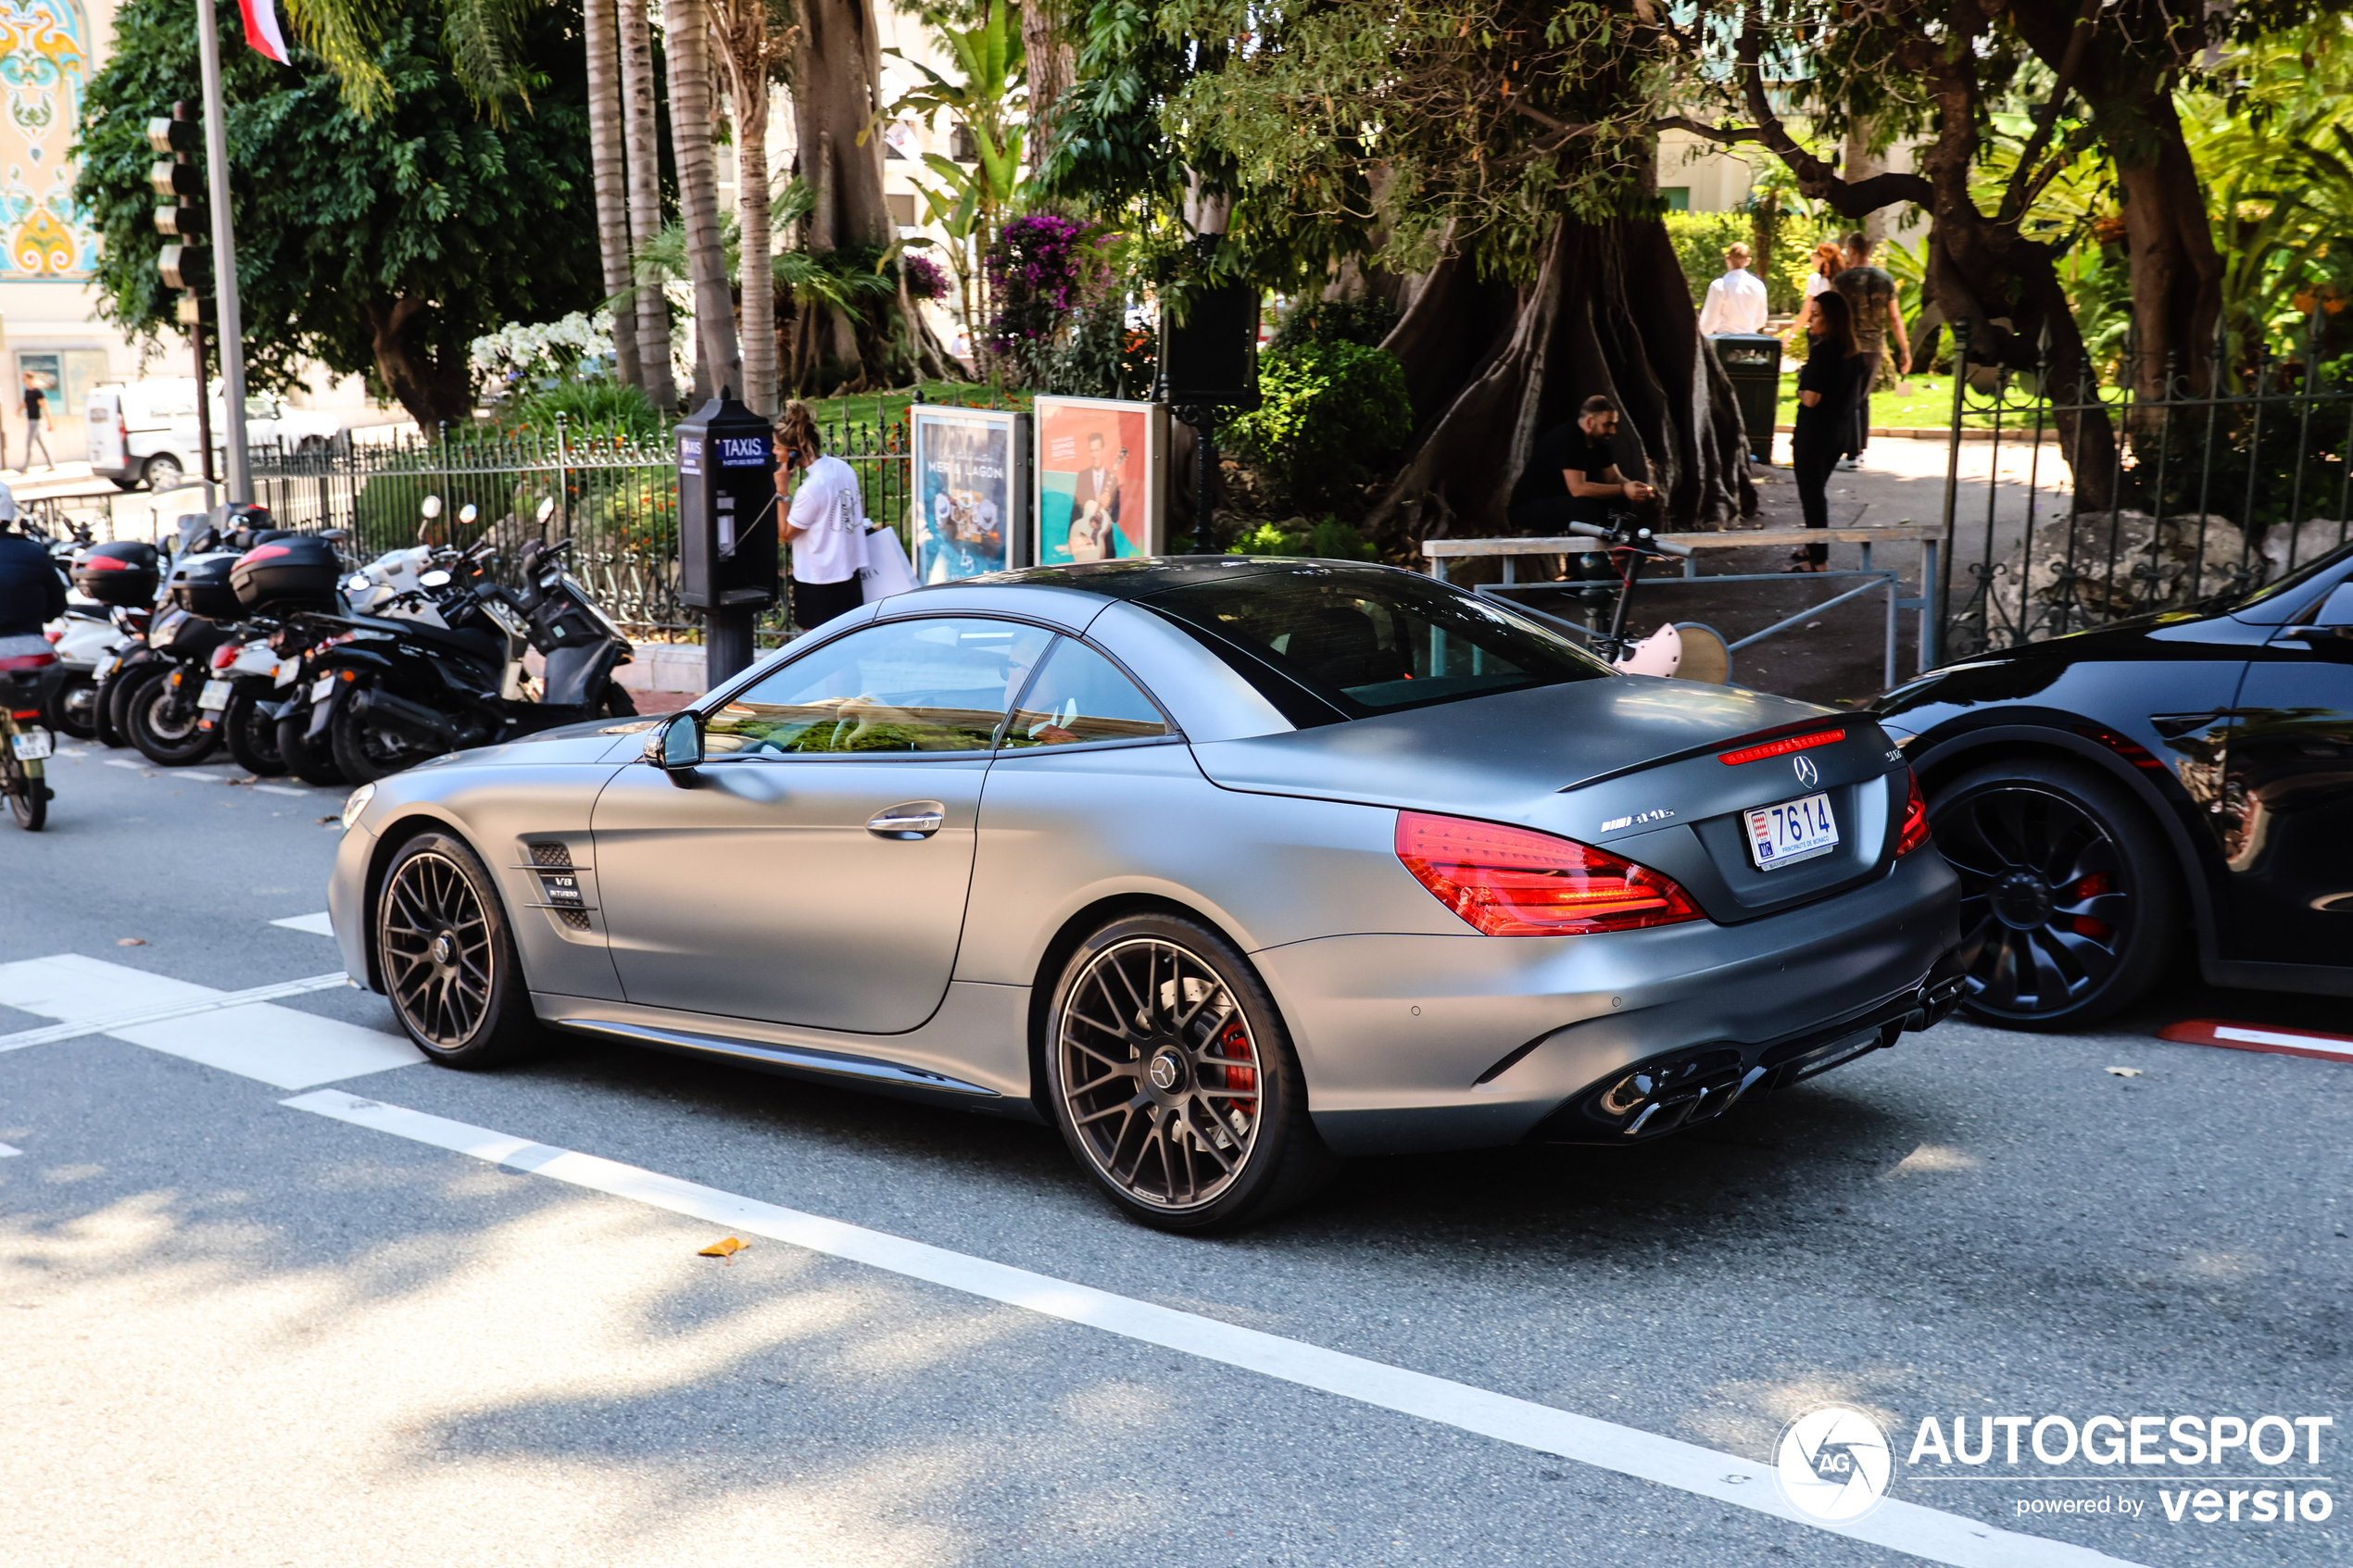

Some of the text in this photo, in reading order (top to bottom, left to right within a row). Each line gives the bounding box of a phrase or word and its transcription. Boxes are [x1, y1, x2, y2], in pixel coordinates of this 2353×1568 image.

[722, 438, 761, 457] TAXIS
[928, 461, 1003, 479] MER & LAGON
[1772, 798, 1830, 846] 7614
[1813, 835, 1830, 845] MONACO
[1761, 844, 1771, 856] MC
[555, 877, 573, 886] V8
